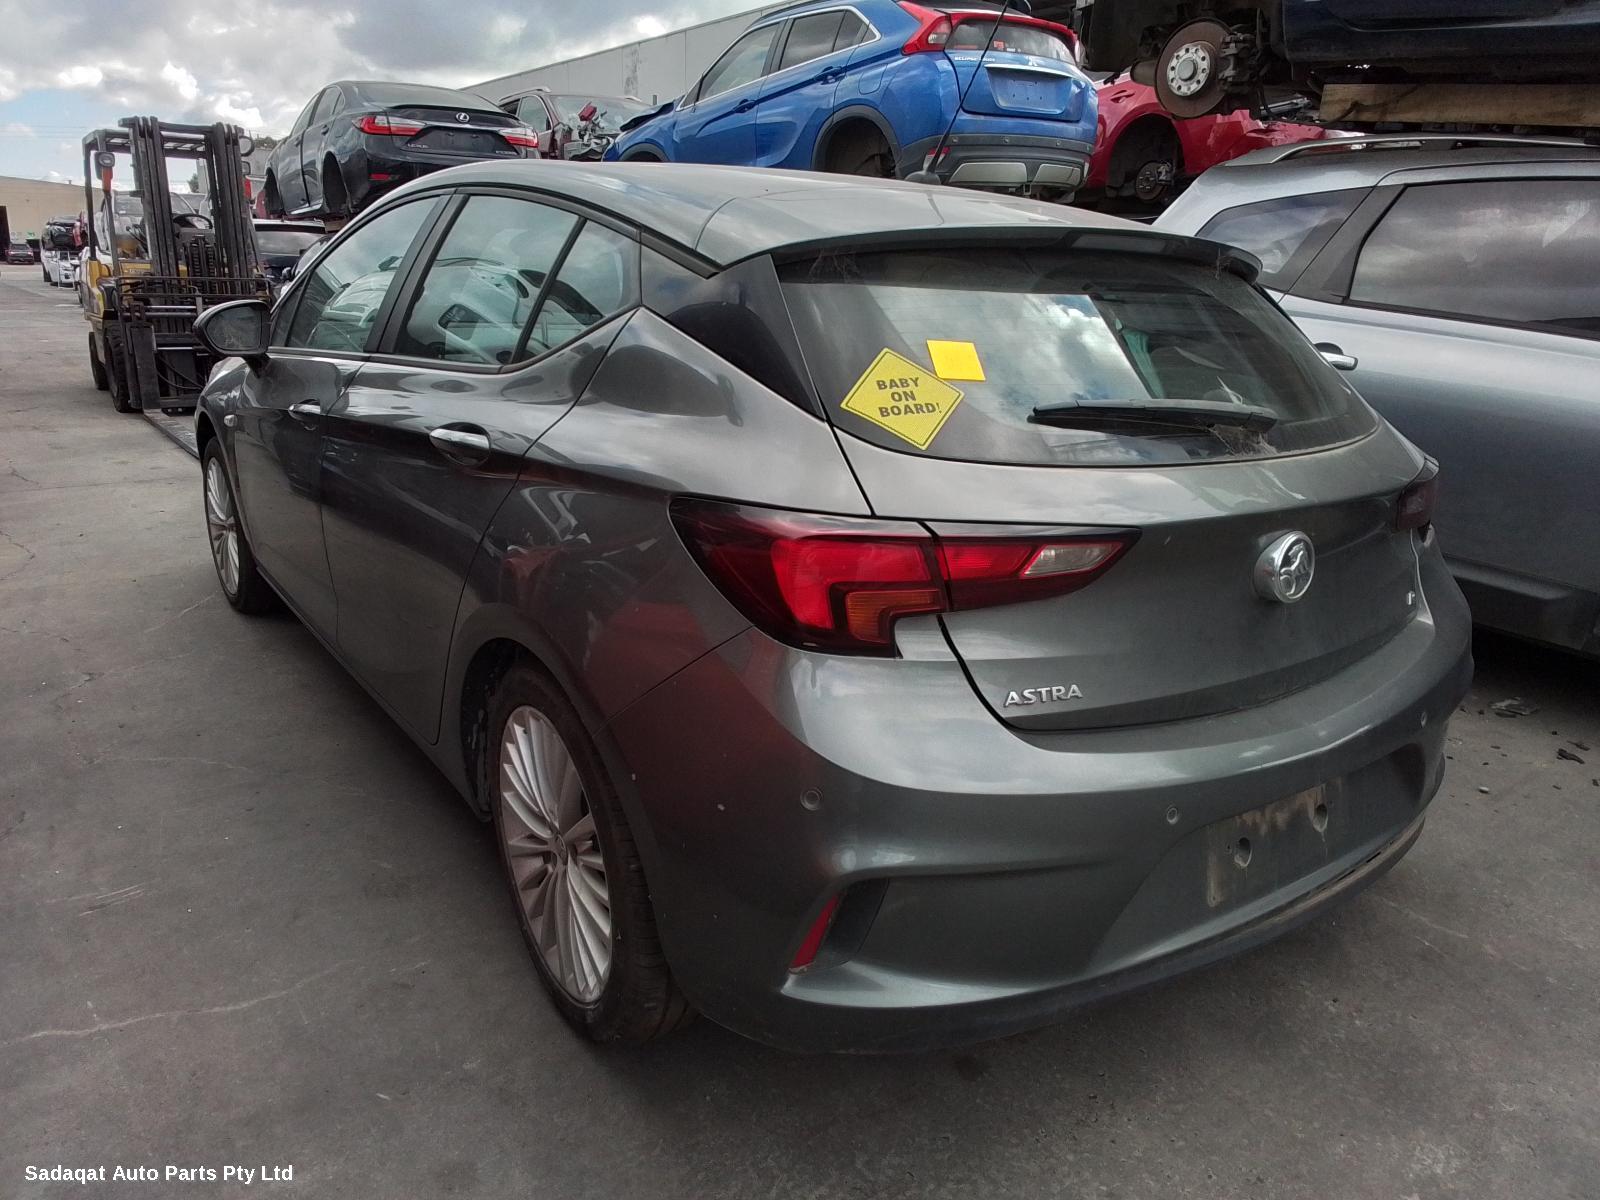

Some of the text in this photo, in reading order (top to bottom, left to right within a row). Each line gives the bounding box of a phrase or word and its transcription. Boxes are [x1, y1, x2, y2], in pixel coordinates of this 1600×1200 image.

[876, 377, 920, 391] BABY
[890, 390, 917, 403] ON
[878, 402, 942, 418] BOARD!
[1004, 684, 1084, 707] ASTRA
